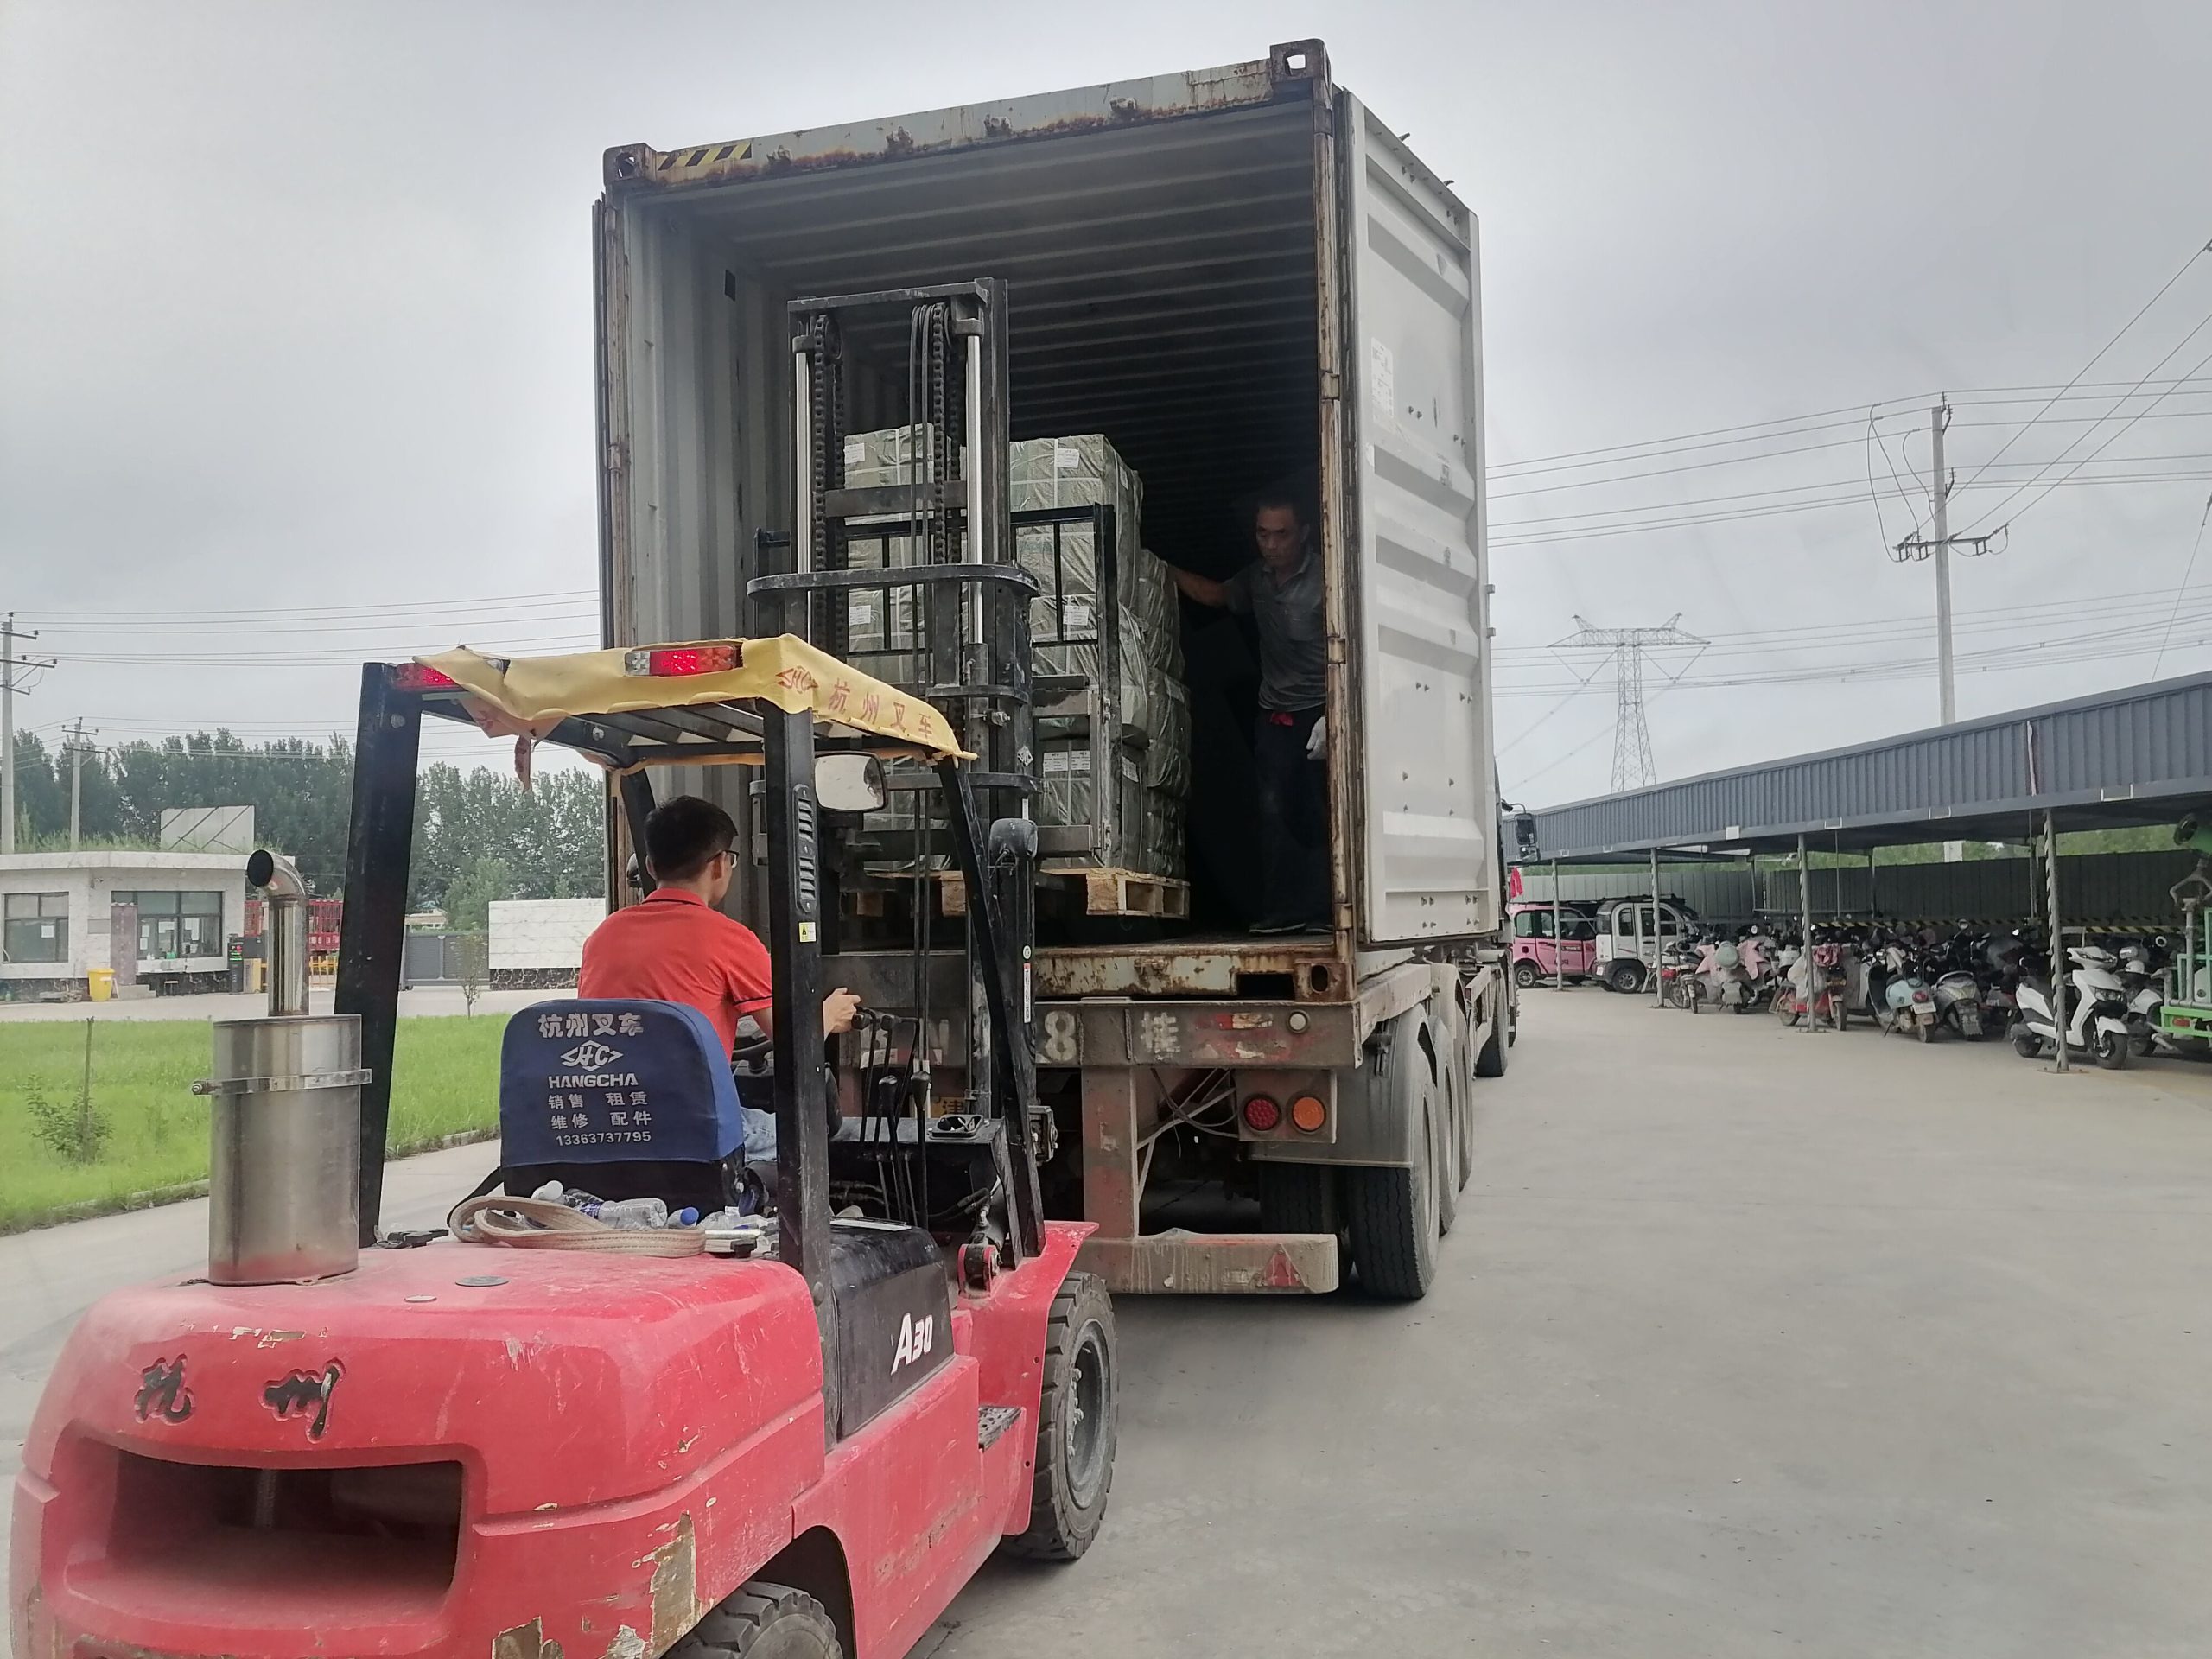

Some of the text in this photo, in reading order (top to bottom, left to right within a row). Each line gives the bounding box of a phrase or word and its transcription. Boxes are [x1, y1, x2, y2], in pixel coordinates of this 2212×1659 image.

[829, 678, 932, 738] 杭州叉车
[538, 1012, 644, 1038] 杭州叉车
[549, 1073, 638, 1089] HANGCHA
[549, 1091, 648, 1110] 销售 租赁
[551, 1111, 652, 1130] 维修 配件
[556, 1131, 652, 1147] 13363737795
[892, 1313, 933, 1375] A30
